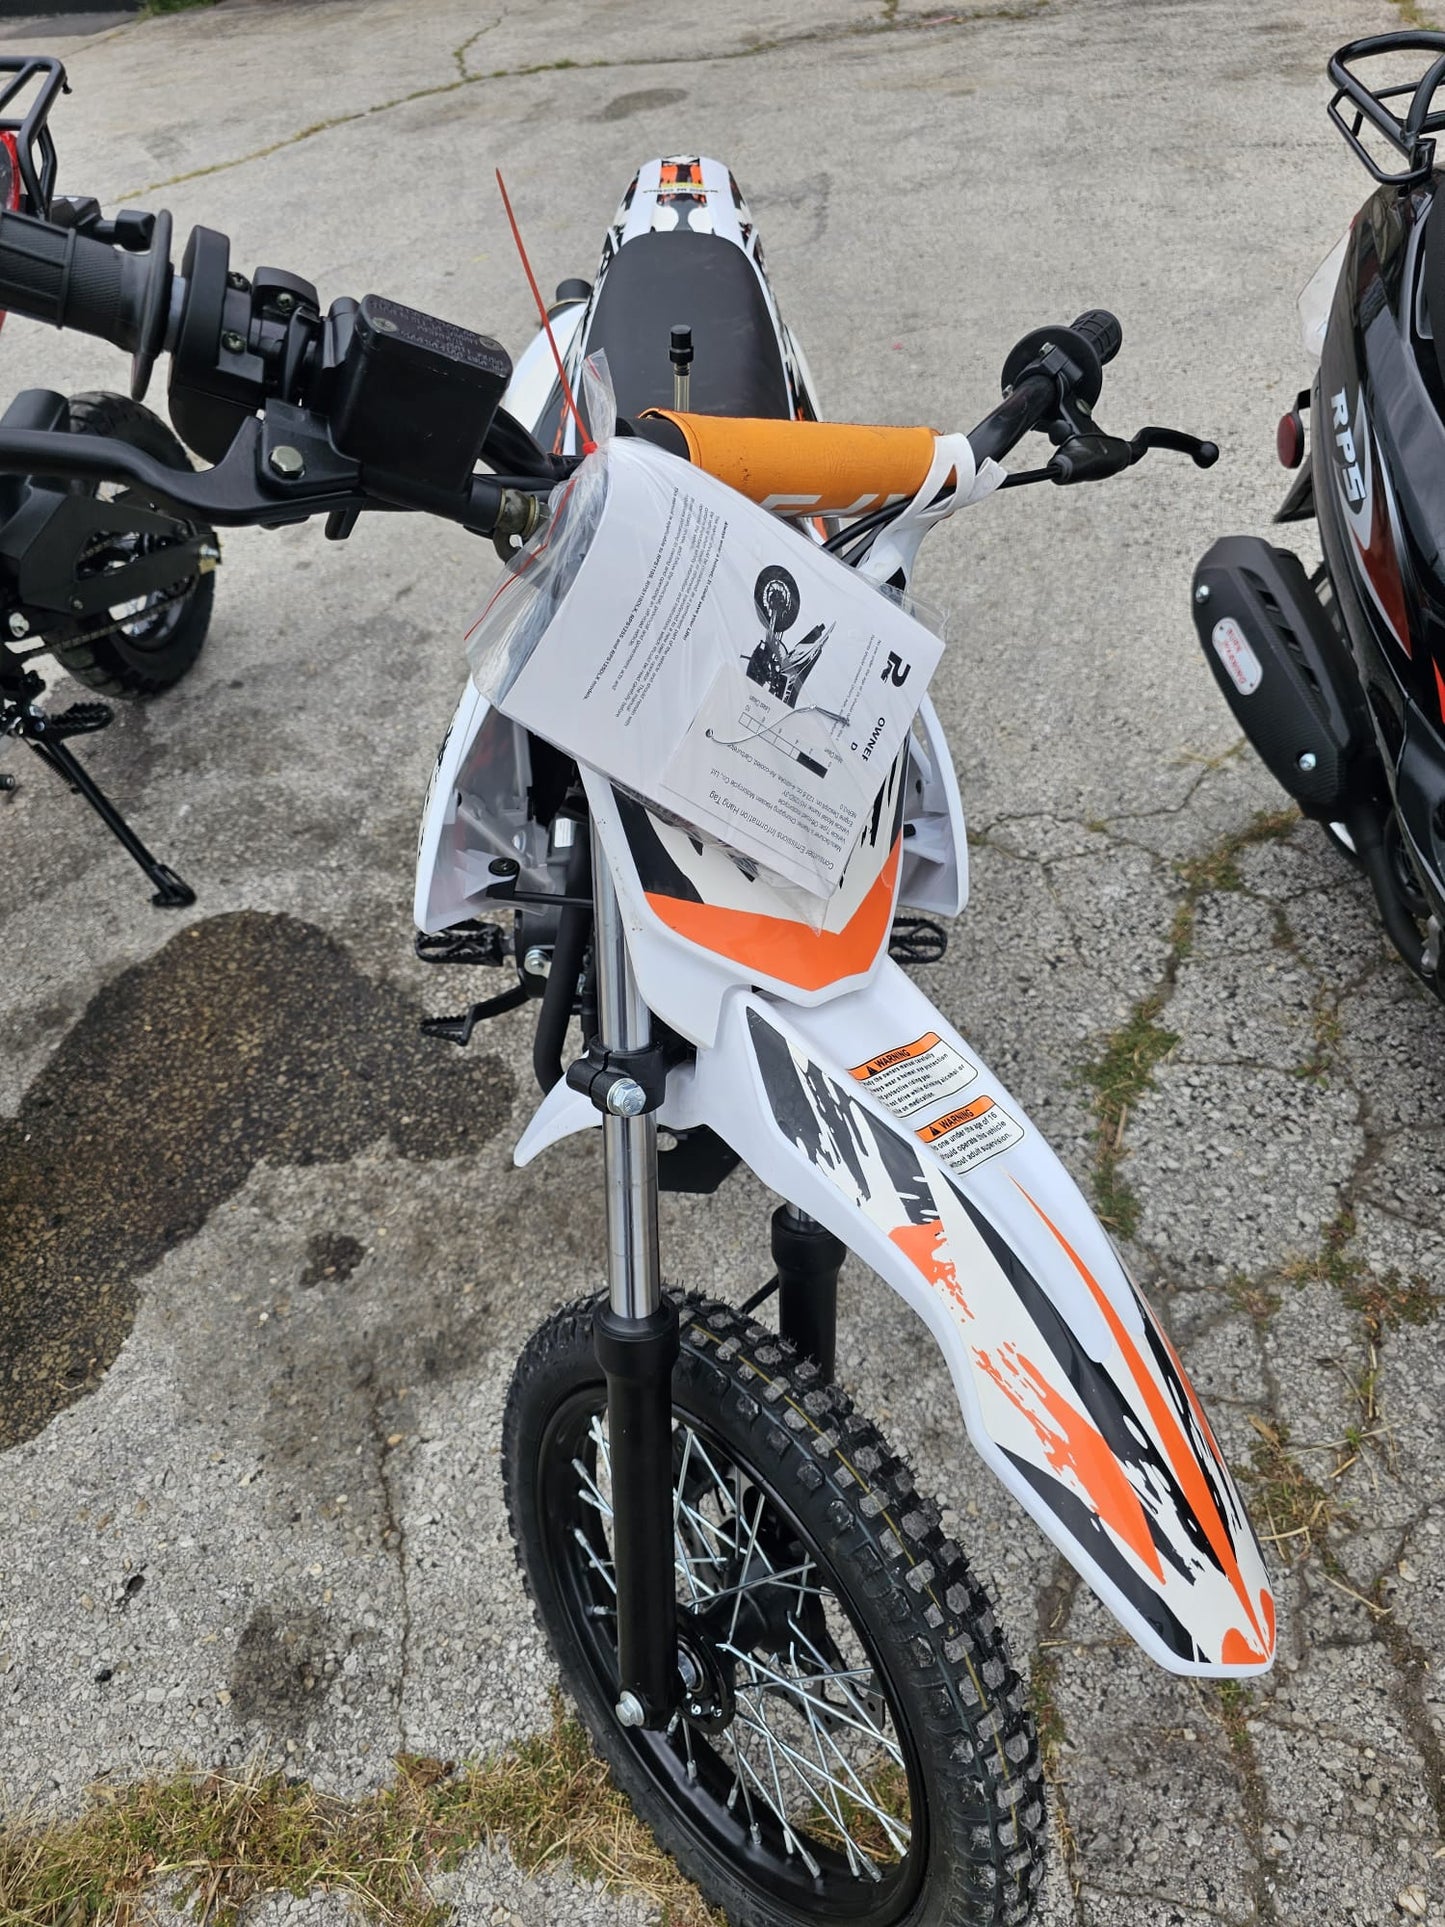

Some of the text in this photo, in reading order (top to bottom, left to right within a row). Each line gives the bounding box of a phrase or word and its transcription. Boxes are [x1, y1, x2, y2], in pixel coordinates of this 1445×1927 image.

[1331, 387, 1366, 501] RPS
[709, 790, 834, 870] Consumer Emissions Information Hang Tag
[875, 1049, 911, 1068] WARNING
[937, 1139, 950, 1149] one
[949, 1129, 965, 1142] under
[982, 1117, 989, 1125] of
[987, 1111, 997, 1120] 16
[940, 1109, 974, 1129] WARNING
[957, 1137, 978, 1151] operate
[976, 1132, 988, 1140] this
[986, 1121, 1006, 1136] vehicle
[966, 1148, 982, 1160] adult
